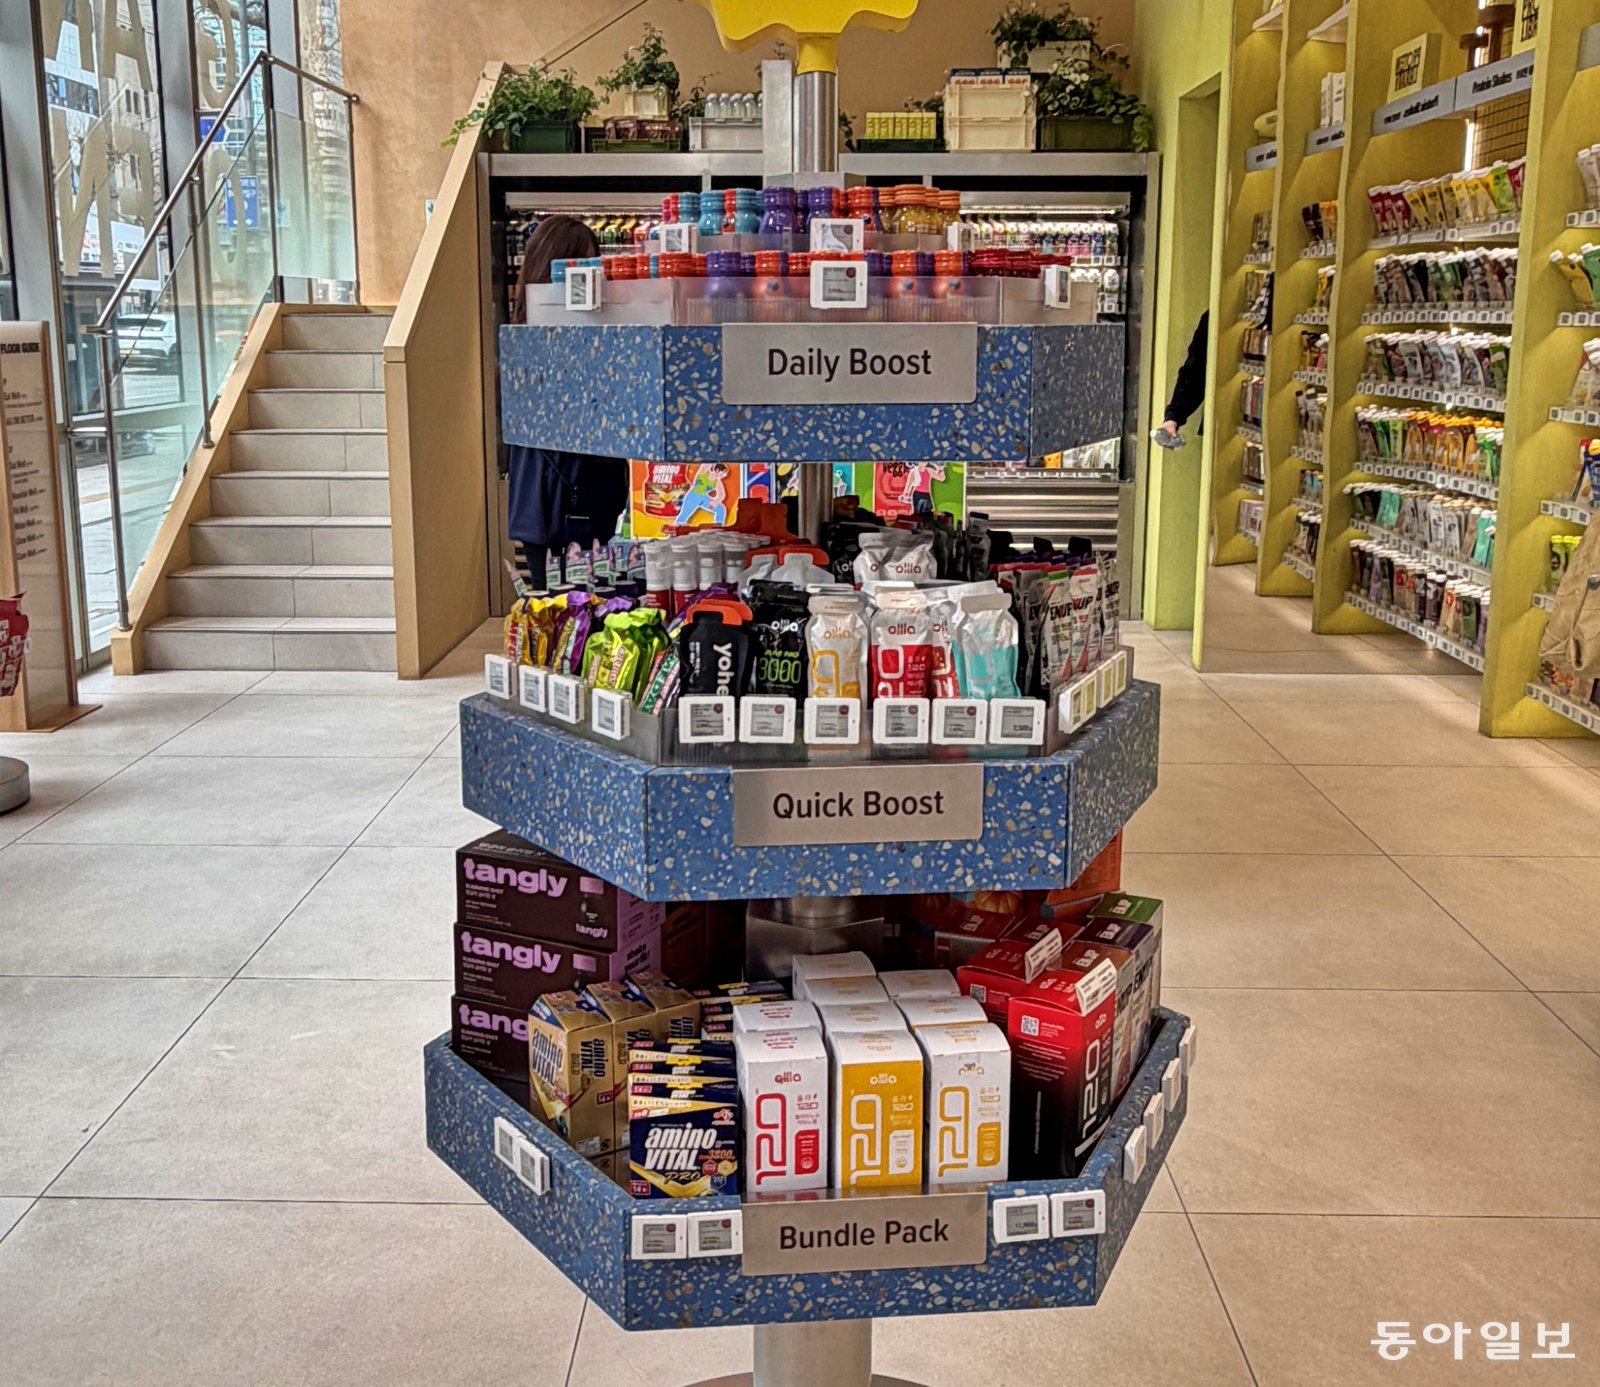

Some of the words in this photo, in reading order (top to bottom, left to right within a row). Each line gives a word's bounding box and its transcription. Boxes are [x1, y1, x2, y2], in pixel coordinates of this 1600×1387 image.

[768, 347, 840, 383] Daily
[849, 348, 932, 380] Boost
[773, 791, 854, 820] Quick
[863, 790, 945, 817] Boost
[463, 857, 568, 899] tangly
[576, 922, 609, 939] tangly
[460, 930, 562, 974] tangly
[458, 1003, 529, 1042] tang
[532, 1027, 564, 1070] amino
[581, 1041, 595, 1072] VITAL
[593, 1038, 609, 1078] amino
[532, 1047, 556, 1087] VITAL
[644, 1122, 718, 1150] amino
[644, 1149, 701, 1171] VITAL
[664, 1171, 702, 1186] PRO
[779, 1223, 876, 1250] Bundle
[885, 1217, 949, 1245] Pack
